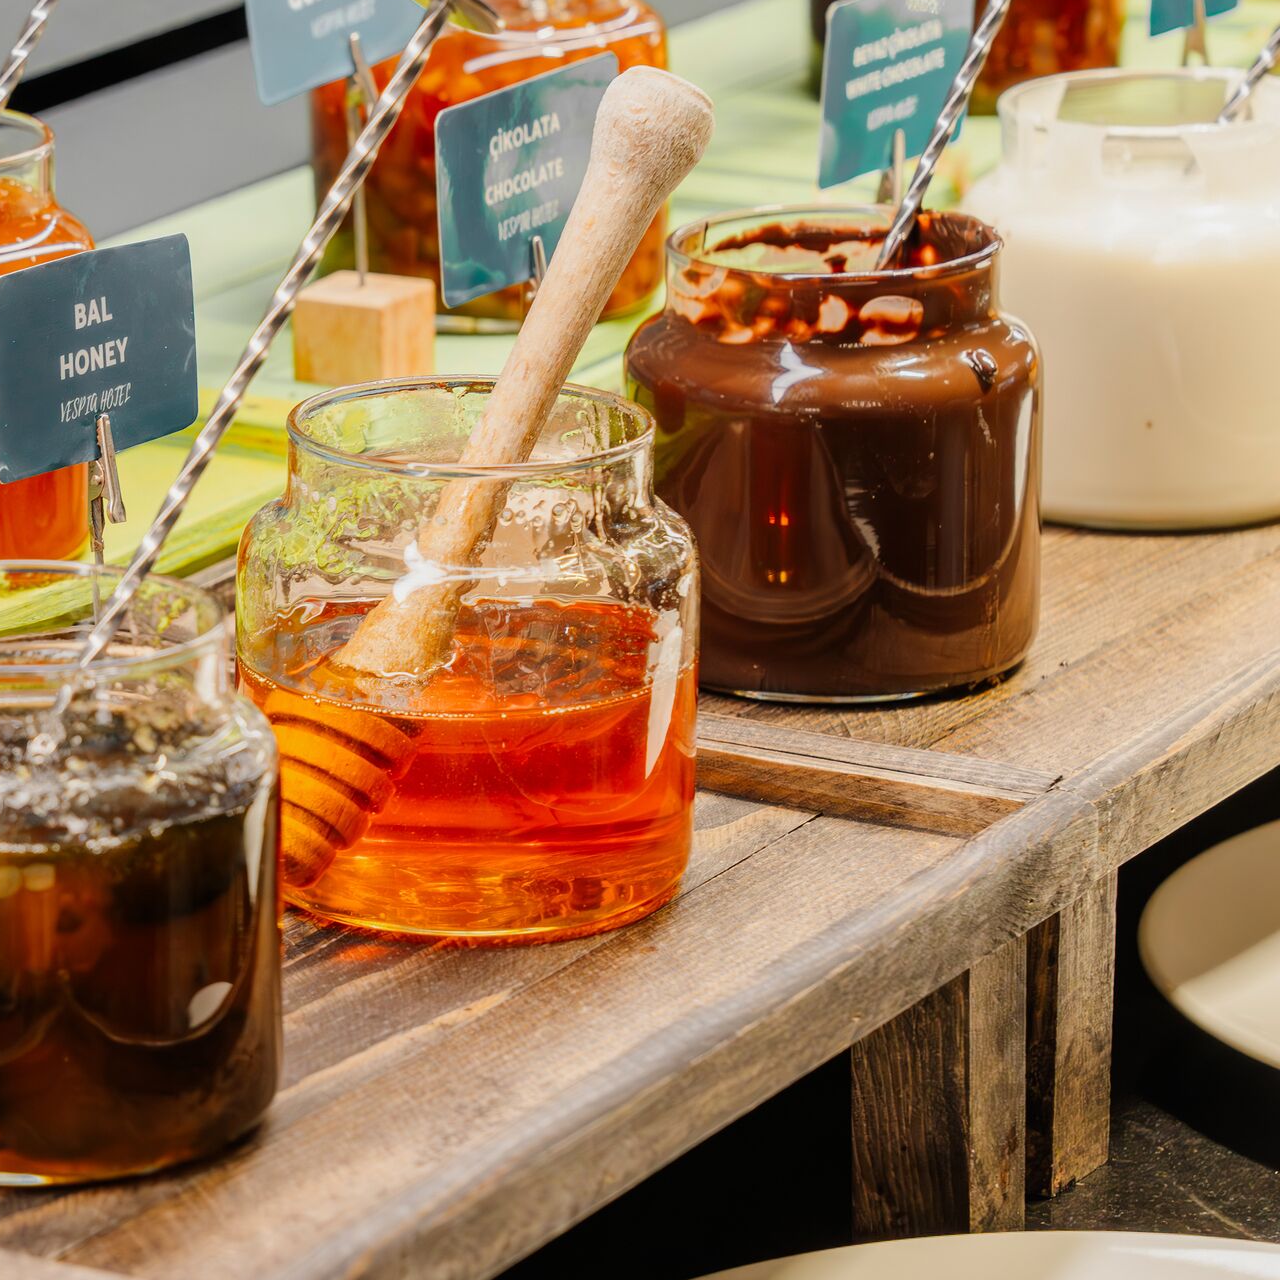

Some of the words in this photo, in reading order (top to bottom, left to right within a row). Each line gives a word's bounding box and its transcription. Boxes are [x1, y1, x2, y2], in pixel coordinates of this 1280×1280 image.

[489, 113, 560, 162] ÇİKOLATA
[485, 157, 564, 206] CHOCOLATE
[74, 296, 113, 330] BAL
[60, 337, 128, 380] HONEY
[100, 382, 131, 411] HOTEL
